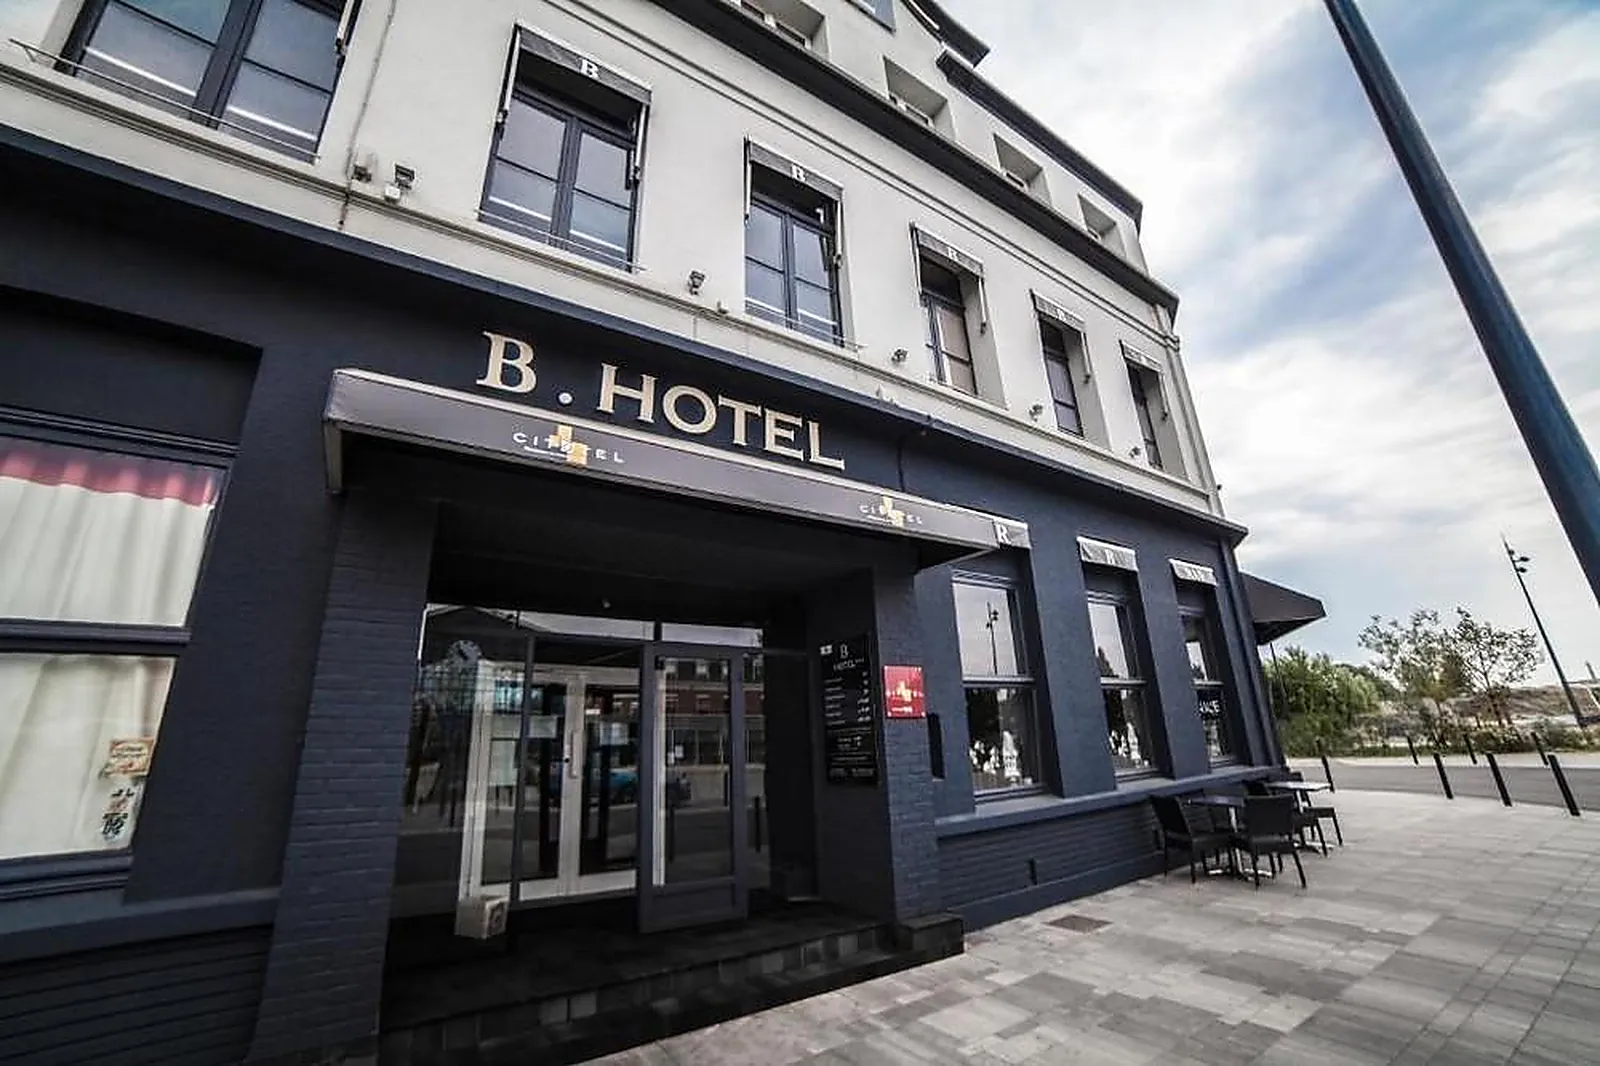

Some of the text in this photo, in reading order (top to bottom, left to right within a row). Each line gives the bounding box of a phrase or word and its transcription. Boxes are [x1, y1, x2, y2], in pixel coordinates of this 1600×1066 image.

[580, 59, 600, 79] B
[596, 362, 845, 470] HOTEL
[512, 430, 626, 465] CITOEL
